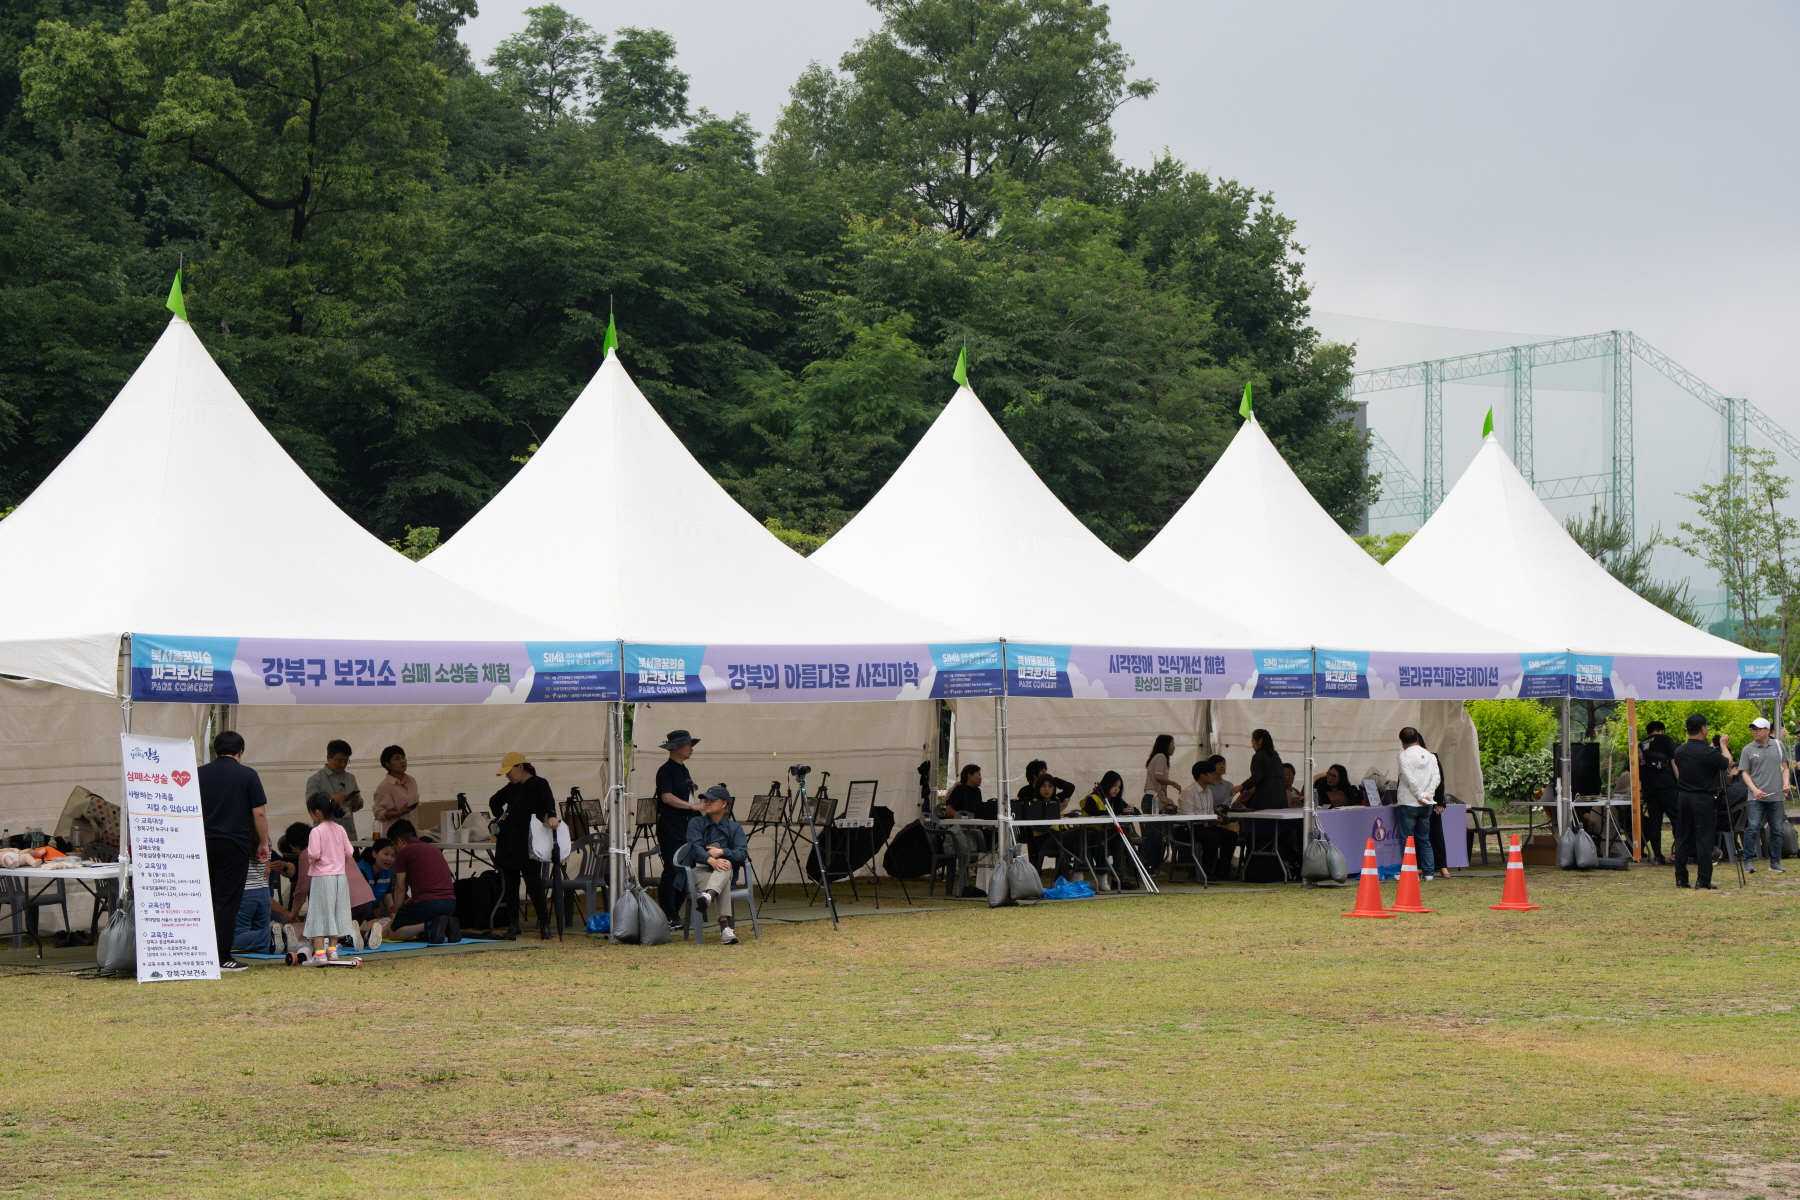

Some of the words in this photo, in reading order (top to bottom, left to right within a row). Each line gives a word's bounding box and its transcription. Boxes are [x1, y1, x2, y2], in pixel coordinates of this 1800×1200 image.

[151, 648, 213, 664] 북서울꿈의숲
[1017, 655, 1055, 666] 북서울꿈의숲
[638, 657, 685, 670] 북서울꿈의숲
[1109, 654, 1153, 674] 시각장애
[1158, 655, 1202, 674] 인식개선
[1204, 655, 1226, 675] 체험
[1325, 660, 1358, 671] 북서울꿈의숲
[151, 664, 214, 681] 파크콘서트
[262, 658, 327, 687] 강북구
[334, 659, 396, 687] 보건소
[401, 662, 431, 683] 심폐
[435, 663, 478, 683] 소생술
[482, 663, 511, 683] 체험
[638, 670, 685, 685] 파크콘서트
[727, 664, 779, 690] 강북의
[784, 663, 850, 689] 아름다운
[856, 661, 919, 687] 사진미학
[1018, 666, 1057, 680] 파크콘서트
[1325, 670, 1358, 683] 파크콘서트
[1398, 666, 1499, 687] 벨라뮤직파운데이션
[1575, 673, 1604, 684] 파크콘서트
[1018, 680, 1032, 688] PARK
[1033, 681, 1057, 689] CONCERT
[1135, 676, 1162, 692] 환상의
[1164, 676, 1182, 692] 문을
[1184, 676, 1202, 692] 열다
[1656, 670, 1703, 690] 한빛예술단
[151, 681, 173, 691] PARK
[175, 682, 213, 693] CONCERT
[638, 685, 655, 693] PARK
[656, 685, 687, 694] CONCERT
[127, 771, 168, 785] 심폐소생술
[128, 790, 153, 800] 사랑하는
[155, 792, 174, 801] 가족을
[146, 803, 160, 812] 지킬
[169, 804, 199, 813] 있습니다!
[141, 817, 164, 825] 교육대상
[165, 969, 208, 978] 강북구보건소
